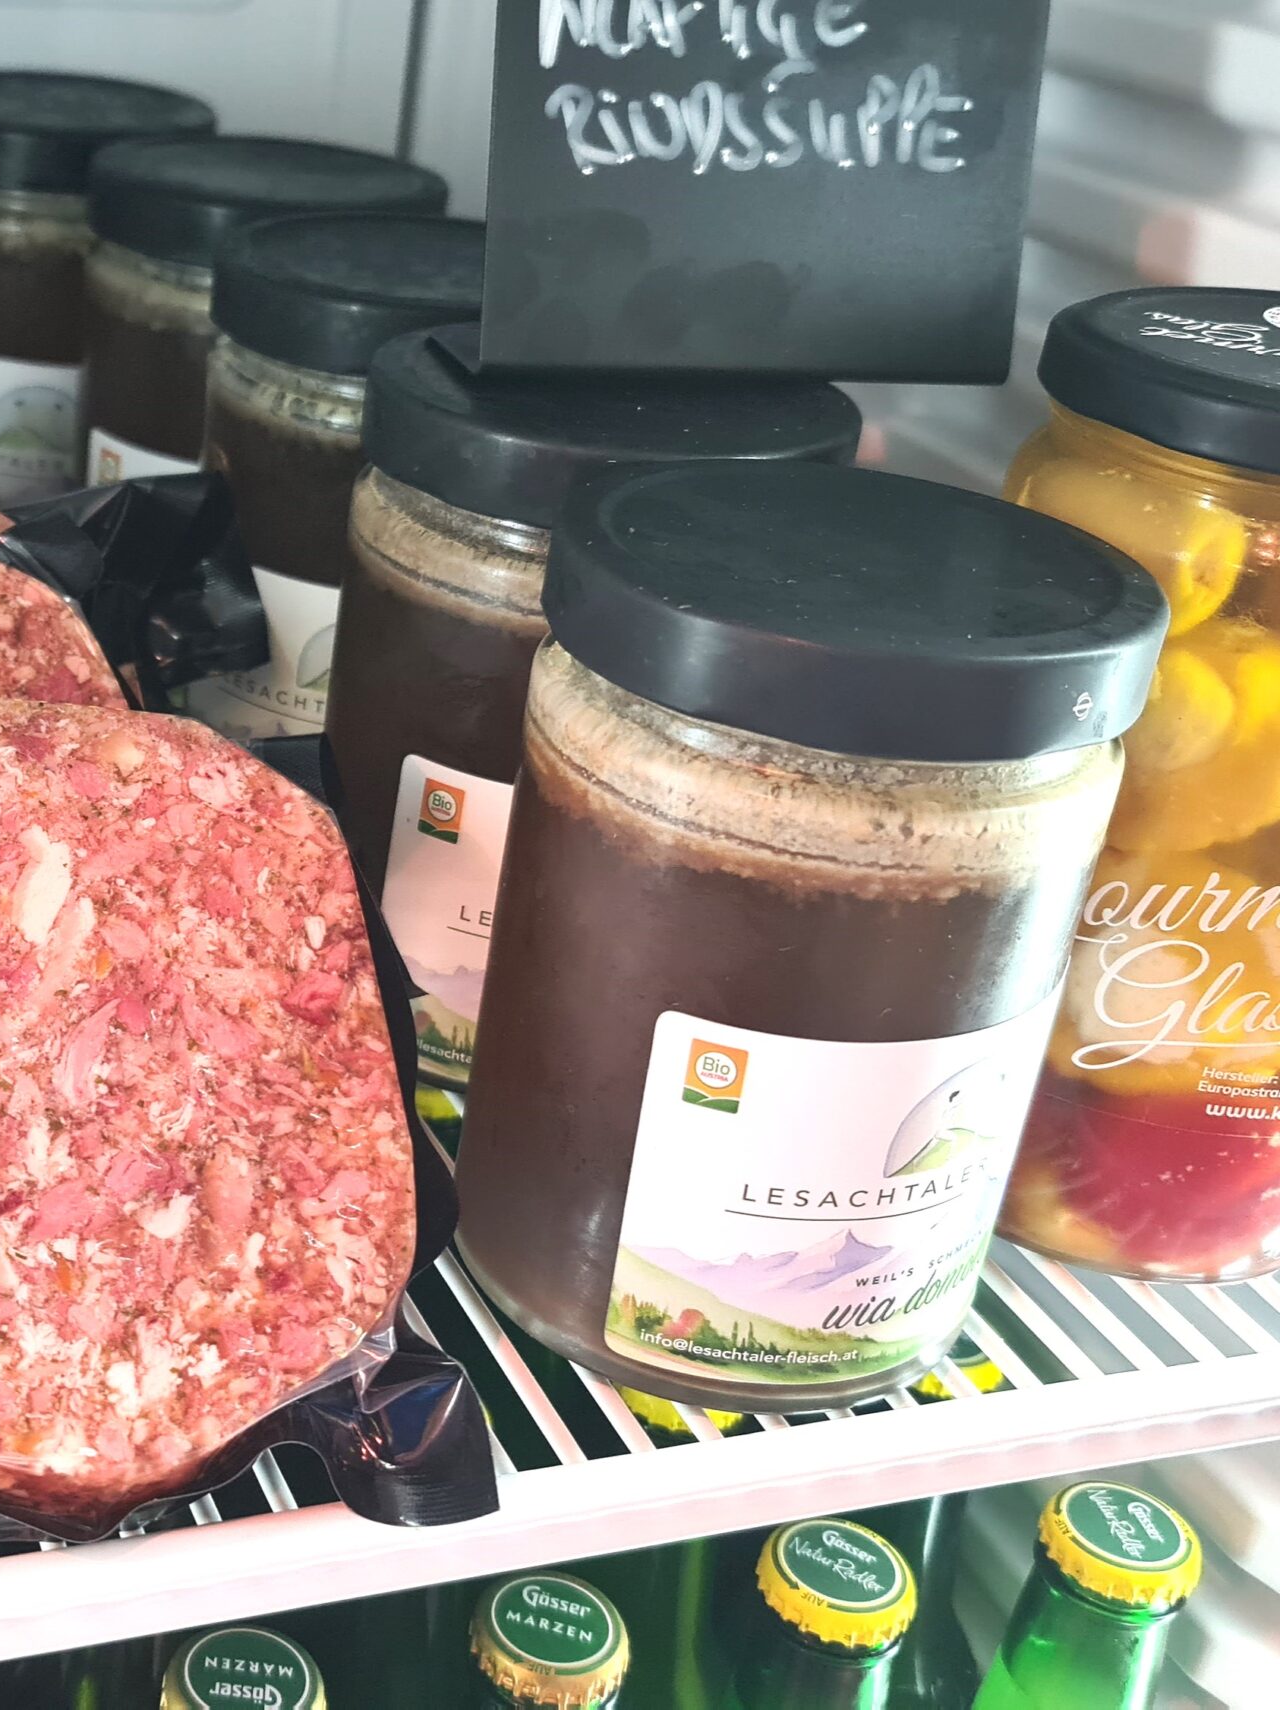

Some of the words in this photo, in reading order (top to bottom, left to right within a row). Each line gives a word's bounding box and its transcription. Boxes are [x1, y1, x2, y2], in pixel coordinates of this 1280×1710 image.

[431, 793, 452, 811] Bio
[416, 1038, 473, 1064] lesachta
[702, 1056, 731, 1075] Bio
[1197, 1080, 1280, 1098] Europastra
[855, 1267, 915, 1288] WEIL'S
[822, 1295, 896, 1331] wia
[639, 1328, 858, 1365] info@lesachtaler-fleisch.at
[821, 1529, 878, 1564] Gösser
[522, 1584, 592, 1618] Gösser
[208, 1681, 283, 1706] Gösser
